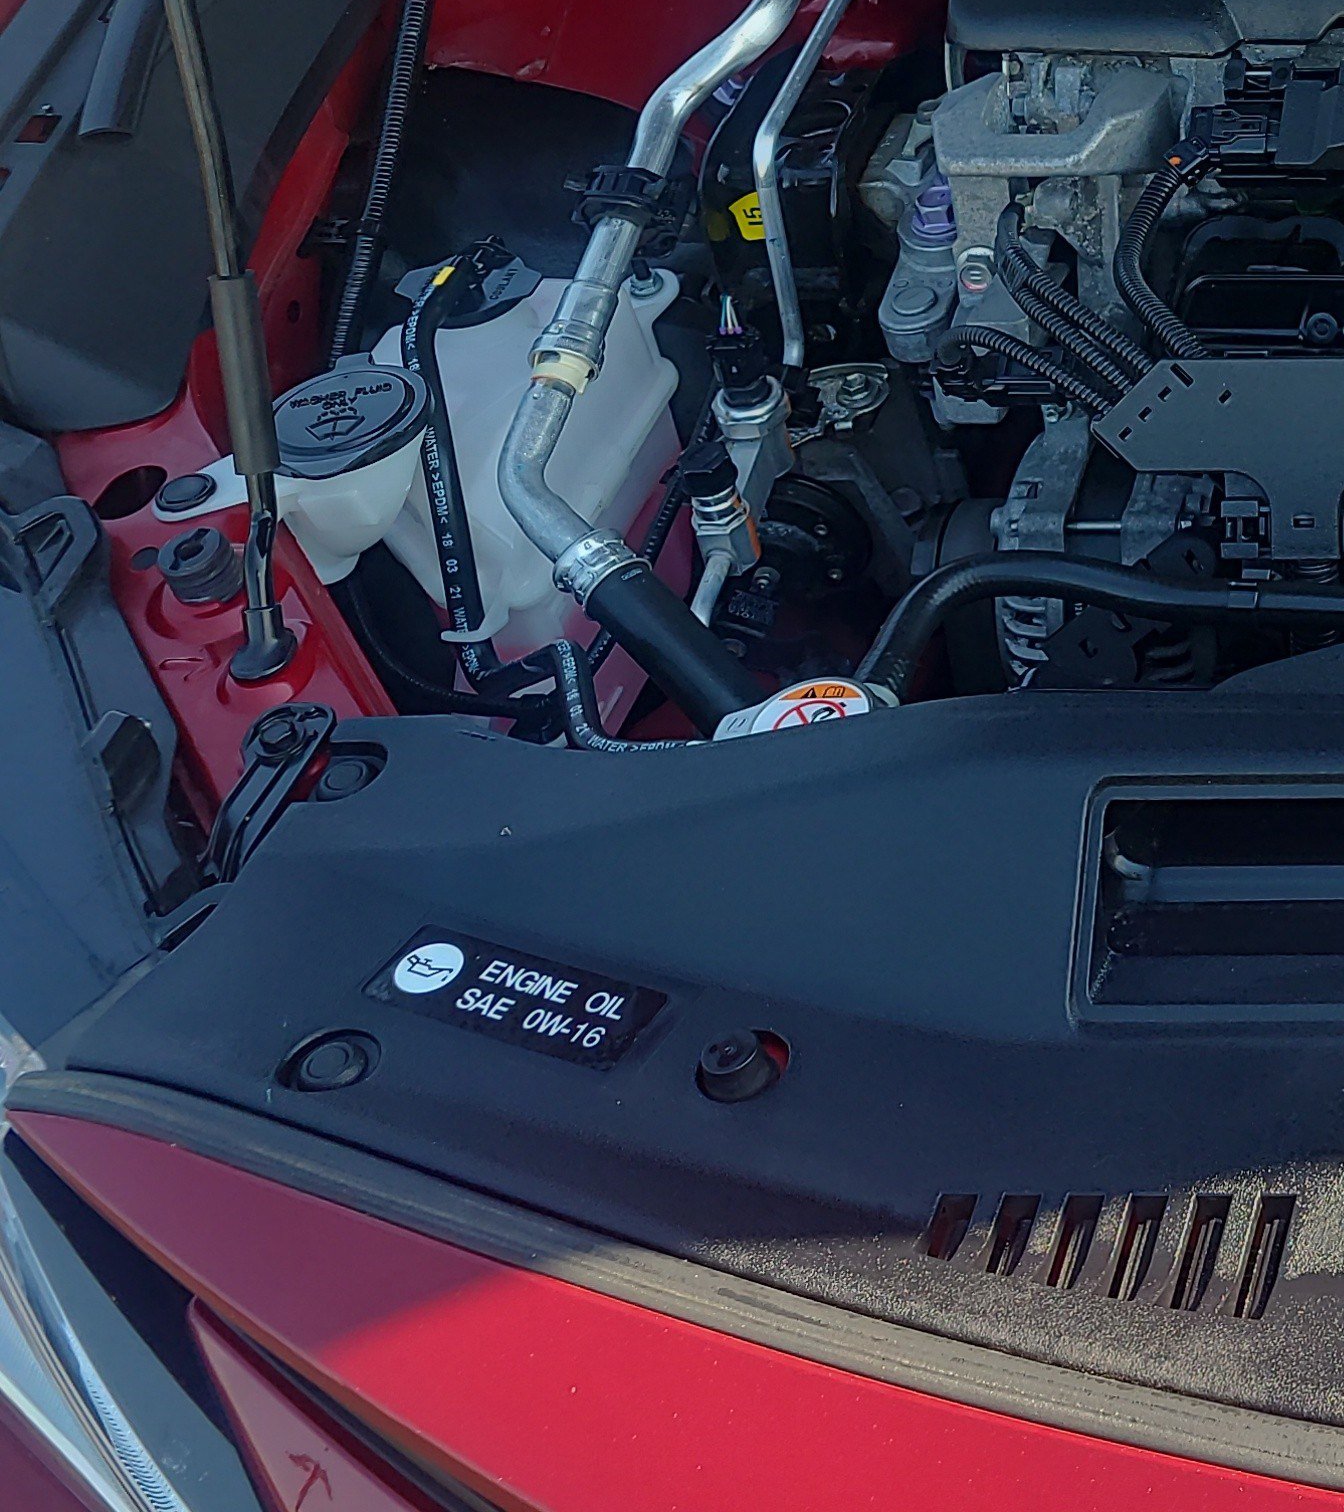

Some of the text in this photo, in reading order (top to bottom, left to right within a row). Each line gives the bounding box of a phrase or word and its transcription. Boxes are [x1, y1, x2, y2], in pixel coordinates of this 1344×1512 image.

[425, 426, 440, 471] WATER
[431, 472, 449, 524] >EPDM<
[441, 531, 454, 547] 18
[445, 558, 459, 574] 03
[449, 586, 462, 600] 21
[587, 734, 628, 753] WATER
[478, 959, 626, 1021] ENGINE OIL
[456, 987, 606, 1048] SAE 0W-16
